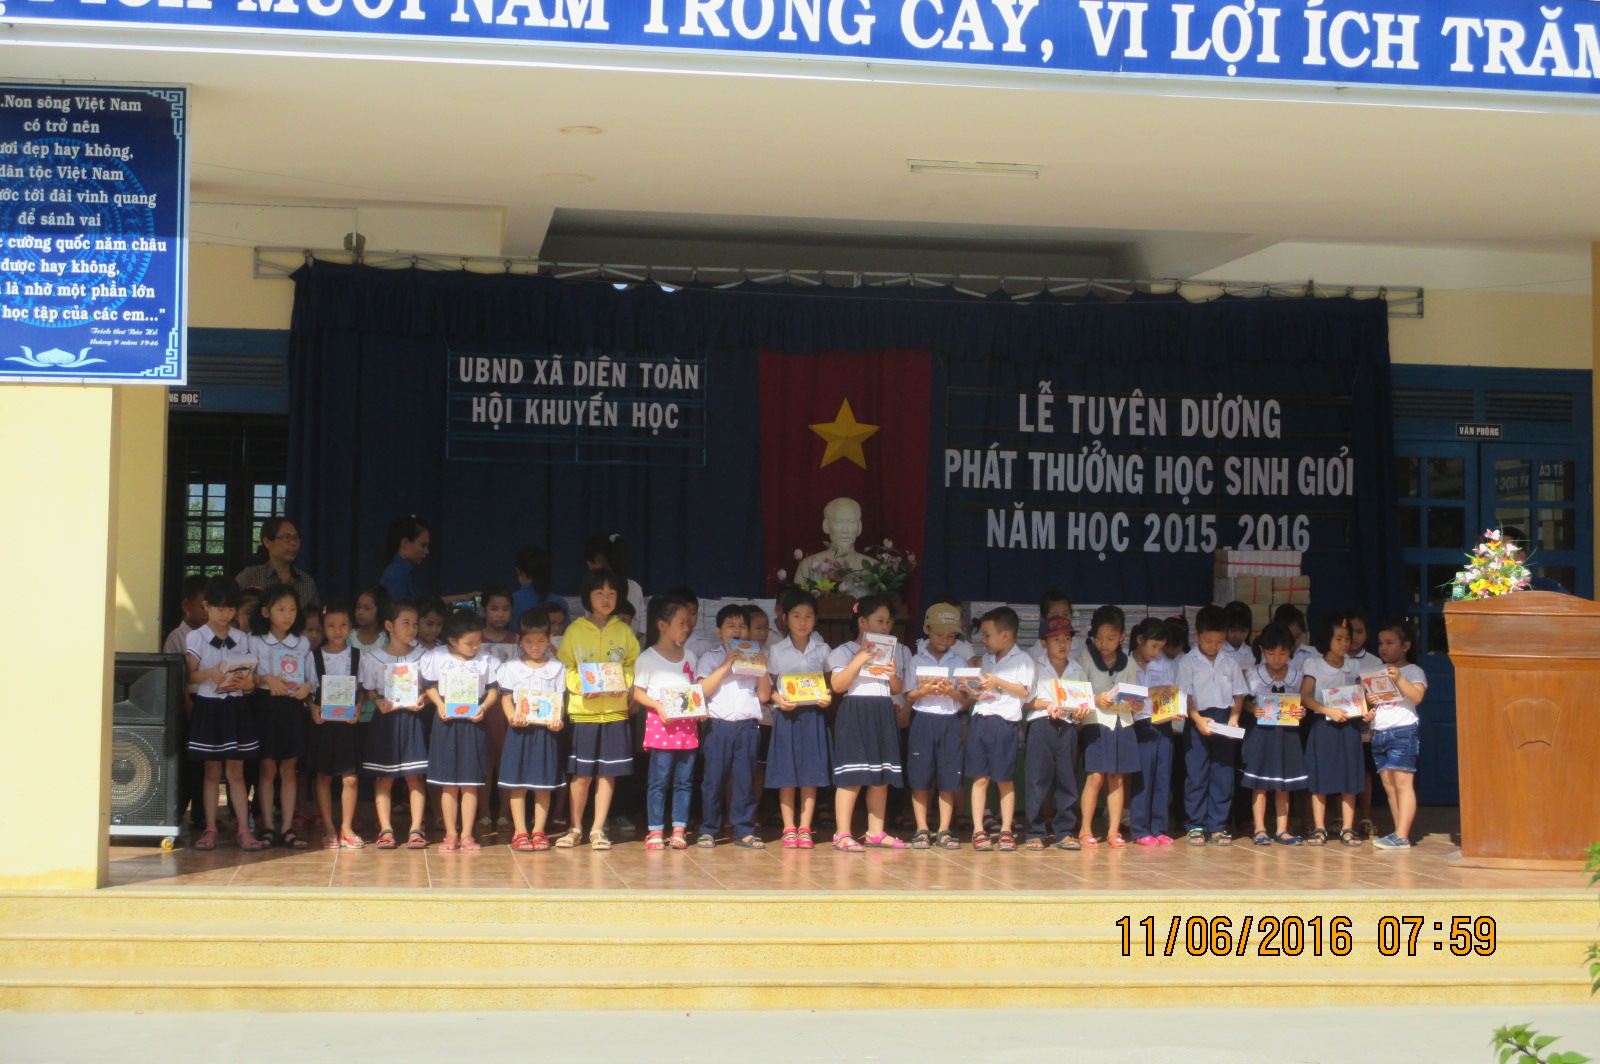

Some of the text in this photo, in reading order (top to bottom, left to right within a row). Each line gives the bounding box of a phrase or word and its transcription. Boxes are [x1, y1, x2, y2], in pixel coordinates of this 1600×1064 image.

[1171, 0, 1281, 76] LỢI
[1303, 0, 1420, 70] ÍCH
[37, 95, 71, 113] sông
[75, 96, 105, 113] Việt
[110, 98, 142, 112] Nam
[24, 118, 100, 134] có trở nên
[23, 141, 49, 159] đẹp
[54, 142, 80, 160] hay
[85, 143, 134, 161] không,
[0, 164, 124, 182] dân tộc Việt Nam
[24, 188, 45, 202] tới
[49, 189, 72, 202] đài
[77, 190, 109, 204] vinh
[114, 193, 157, 209] quang
[18, 208, 101, 227] để sánh vai
[8, 234, 52, 253] cường
[56, 234, 90, 253] quốc
[95, 237, 127, 251] năm
[131, 237, 167, 252] châu
[1, 258, 120, 278] được hay không,
[6, 281, 19, 295] là
[24, 282, 53, 296] nhờ
[57, 284, 86, 300] một
[91, 280, 128, 300] phần
[132, 283, 156, 298] lớn
[2, 305, 29, 321] học
[34, 306, 58, 323] tập
[63, 305, 89, 320] của
[93, 307, 118, 321] các
[459, 354, 699, 389] UBND XÃ DIÊN TOÀN
[181, 393, 199, 405] ĐỌC
[472, 391, 679, 435] HỘI KHUYẾN HỌC
[1018, 380, 1281, 439] LỄ TUYÊN DƯƠNG
[1459, 425, 1500, 437] VĂN PHÒNG
[945, 440, 1354, 505] PHÁT THƯỞNG HỌC SINH GIỎI
[987, 501, 1056, 550] NĂM
[1067, 511, 1130, 561] HỌC
[1143, 513, 1218, 553] 2015
[1238, 513, 1310, 553] 2016
